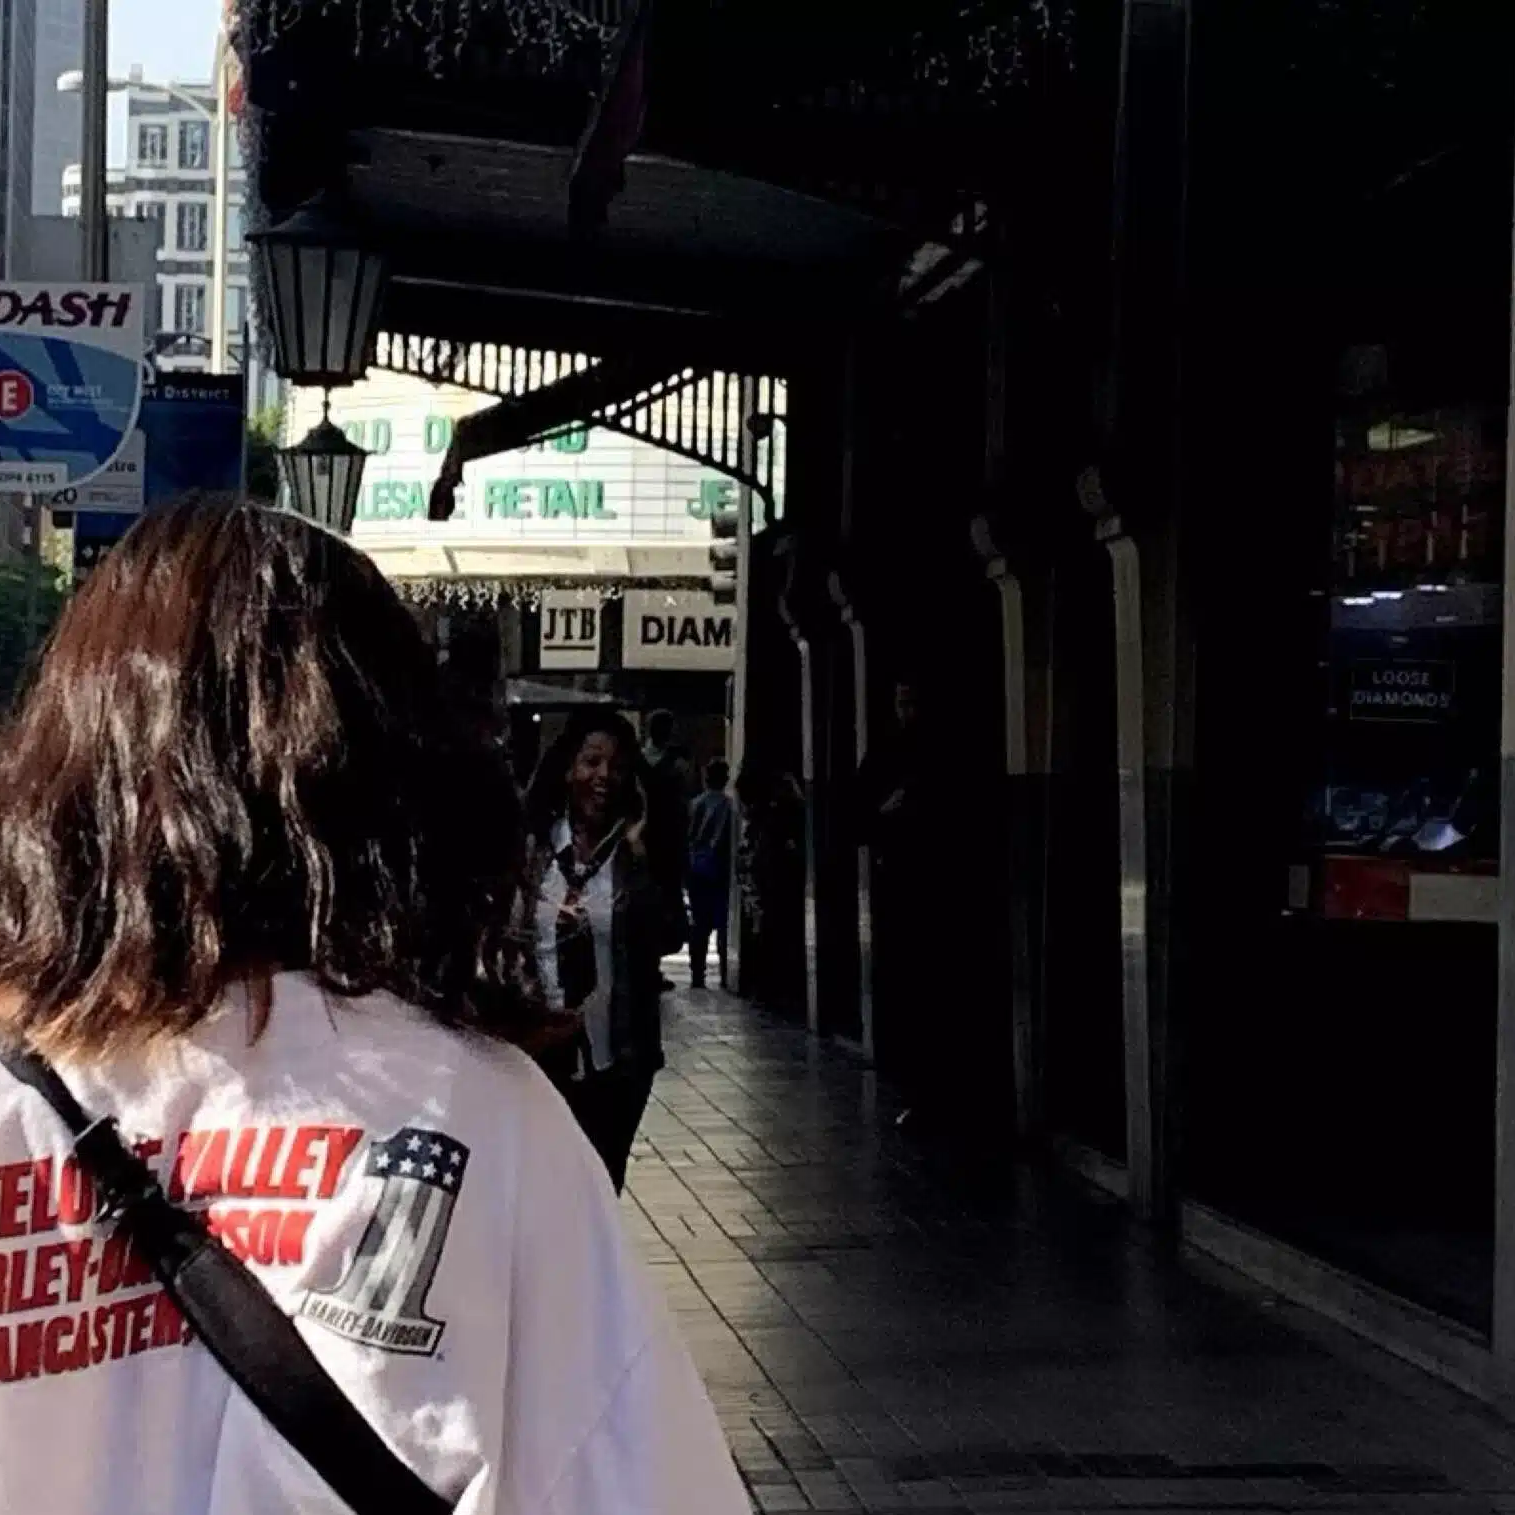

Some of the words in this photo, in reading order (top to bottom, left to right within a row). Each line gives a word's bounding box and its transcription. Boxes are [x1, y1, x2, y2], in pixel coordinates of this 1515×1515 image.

[0, 381, 20, 411] E
[107, 459, 137, 473] etro
[485, 477, 617, 520] RETAIL
[543, 607, 597, 643] JTB
[640, 615, 733, 648] DIAM
[1372, 671, 1430, 686] LOOSE
[1352, 690, 1451, 708] DIAMONDS
[169, 1124, 364, 1201] VALLEY
